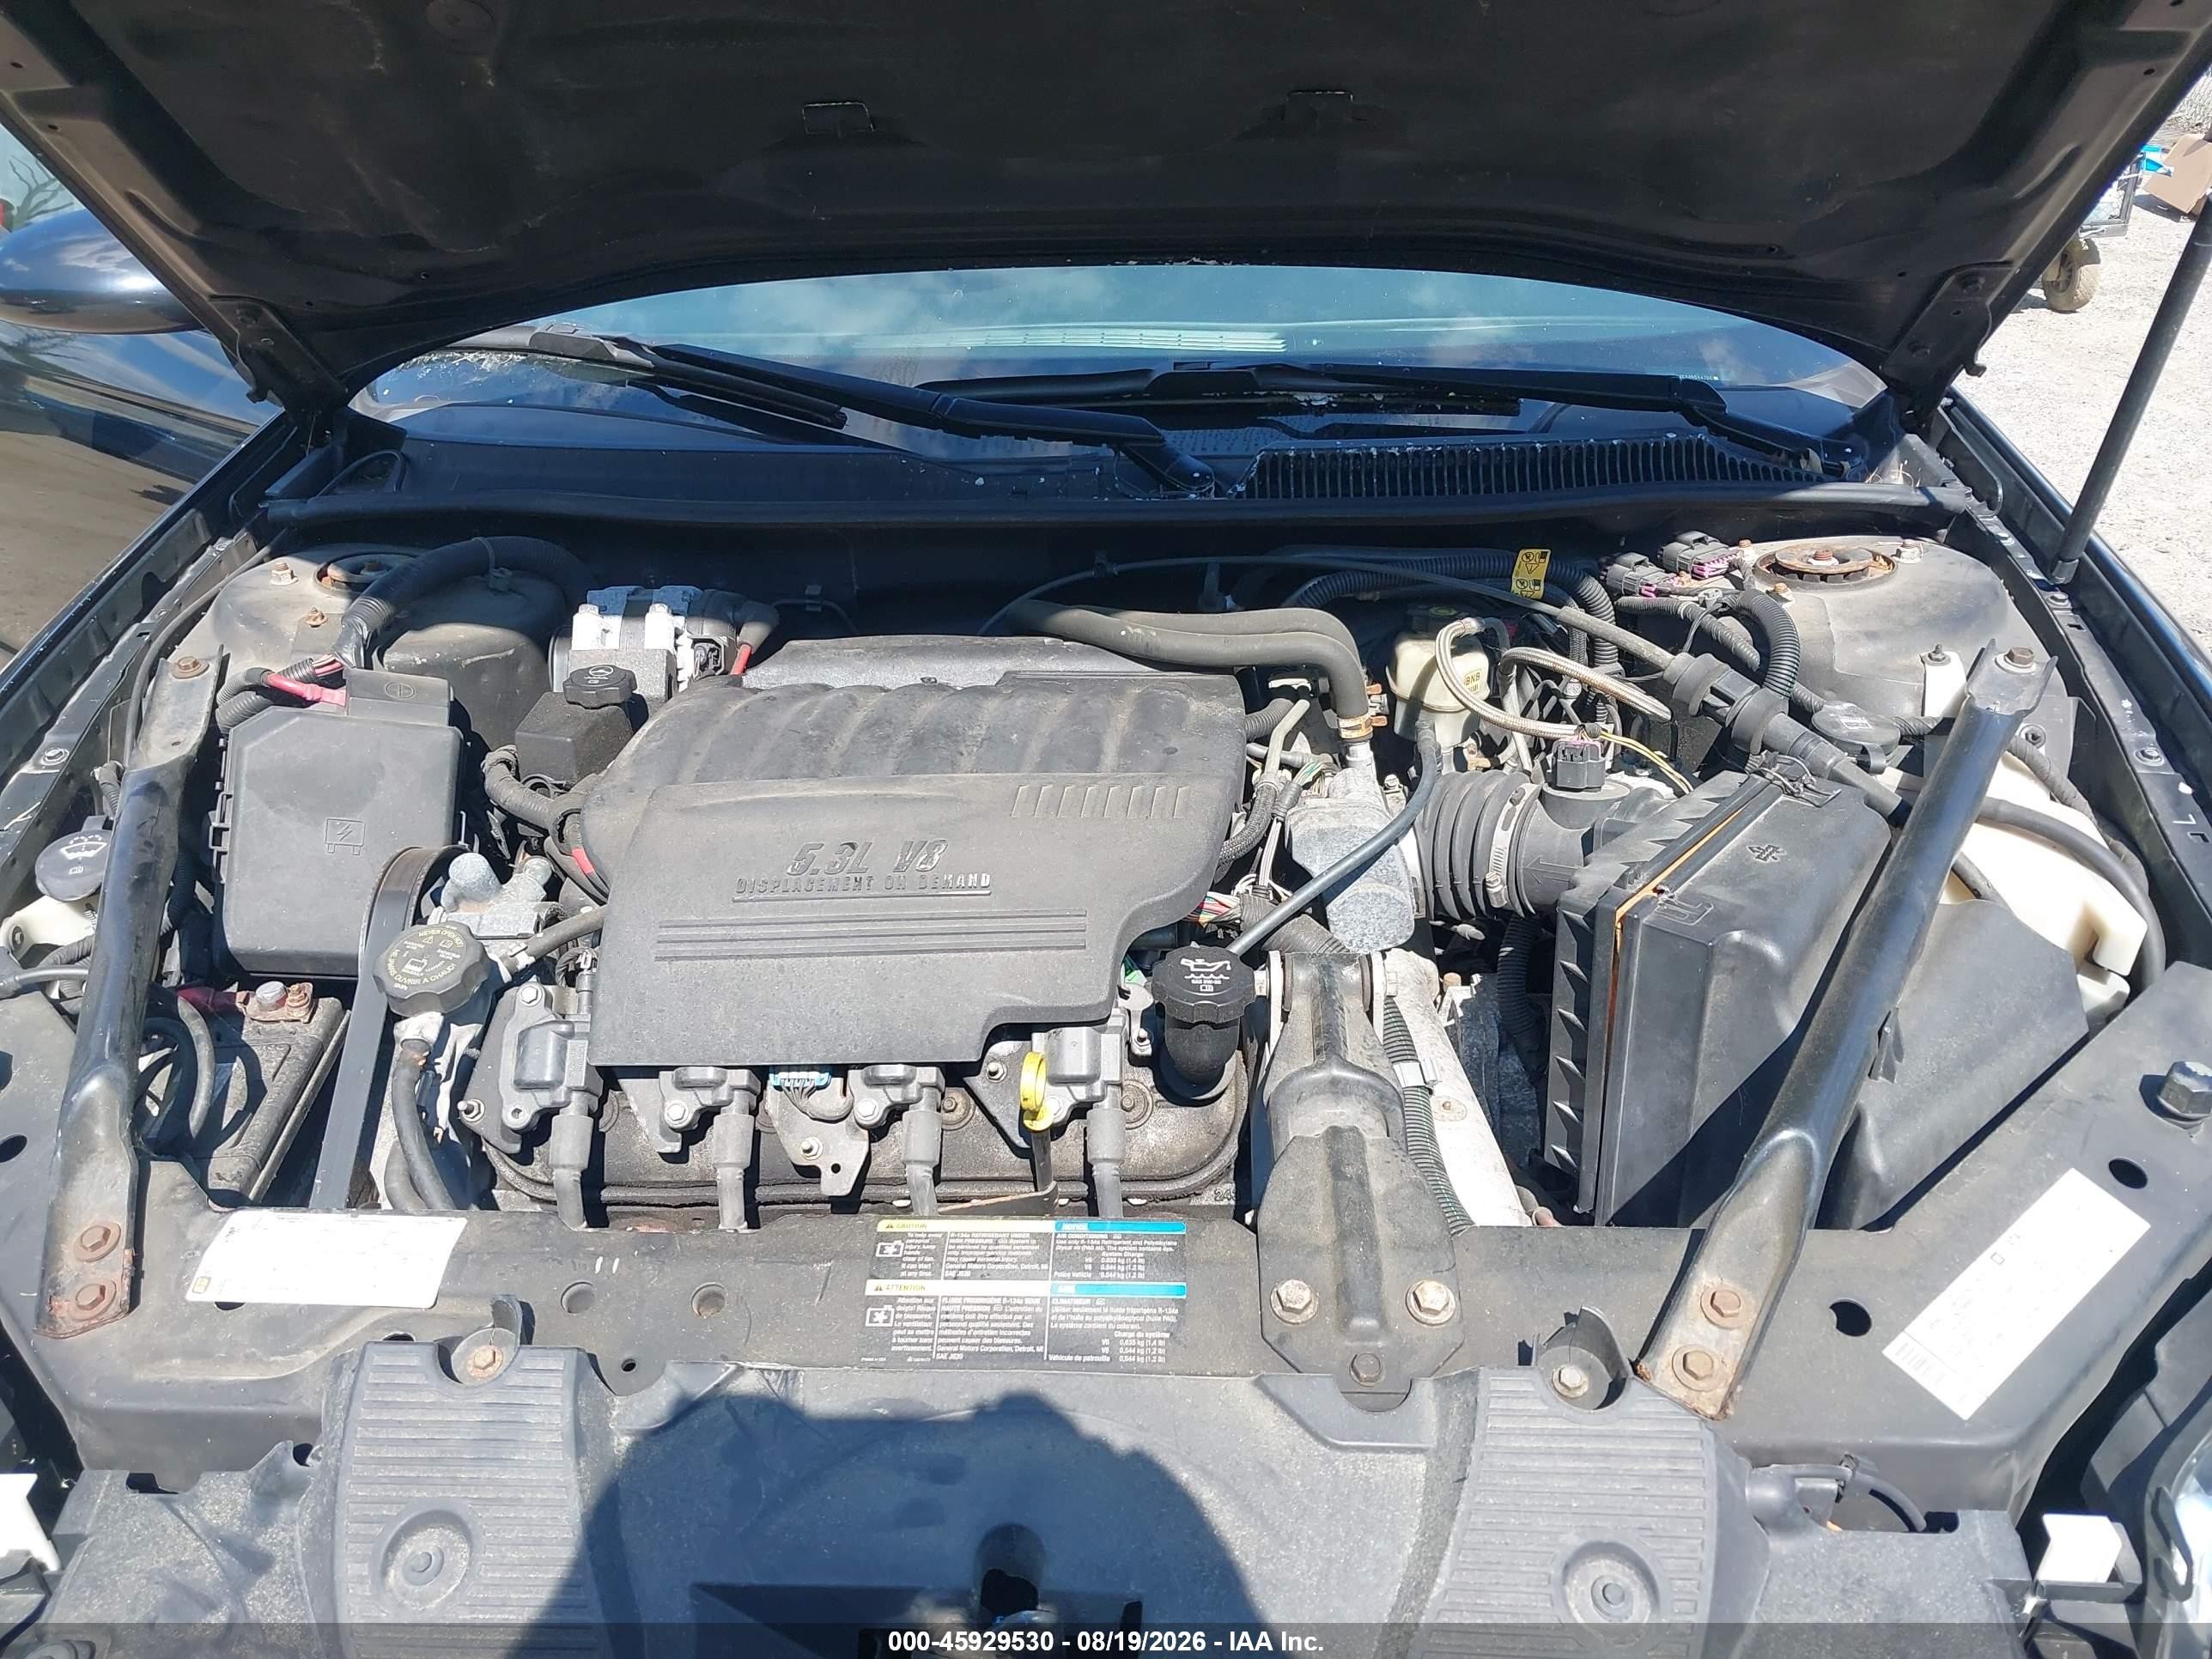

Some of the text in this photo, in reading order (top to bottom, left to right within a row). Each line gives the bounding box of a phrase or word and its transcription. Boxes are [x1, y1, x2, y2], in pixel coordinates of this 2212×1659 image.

[787, 839, 948, 876] 5.3L V8
[736, 873, 992, 894] DISPLACEMENT ON DEMAND
